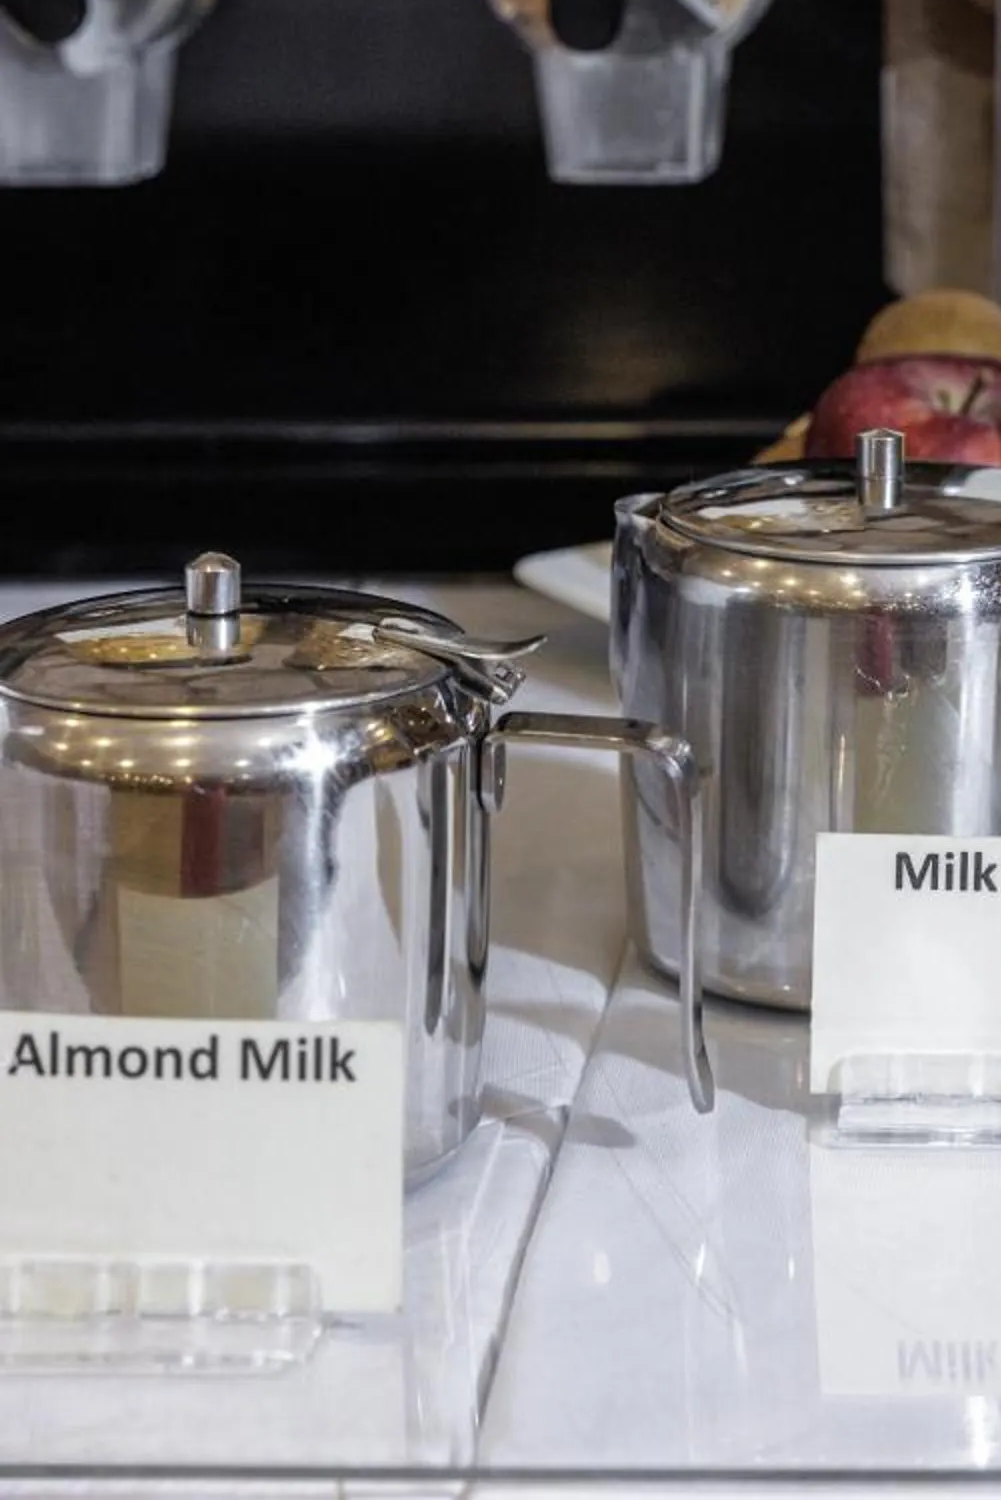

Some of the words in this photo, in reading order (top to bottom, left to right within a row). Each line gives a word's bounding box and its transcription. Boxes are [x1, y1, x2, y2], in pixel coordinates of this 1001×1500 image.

[894, 851, 998, 894] Milk
[7, 1030, 220, 1081] Almond
[239, 1036, 357, 1083] Milk
